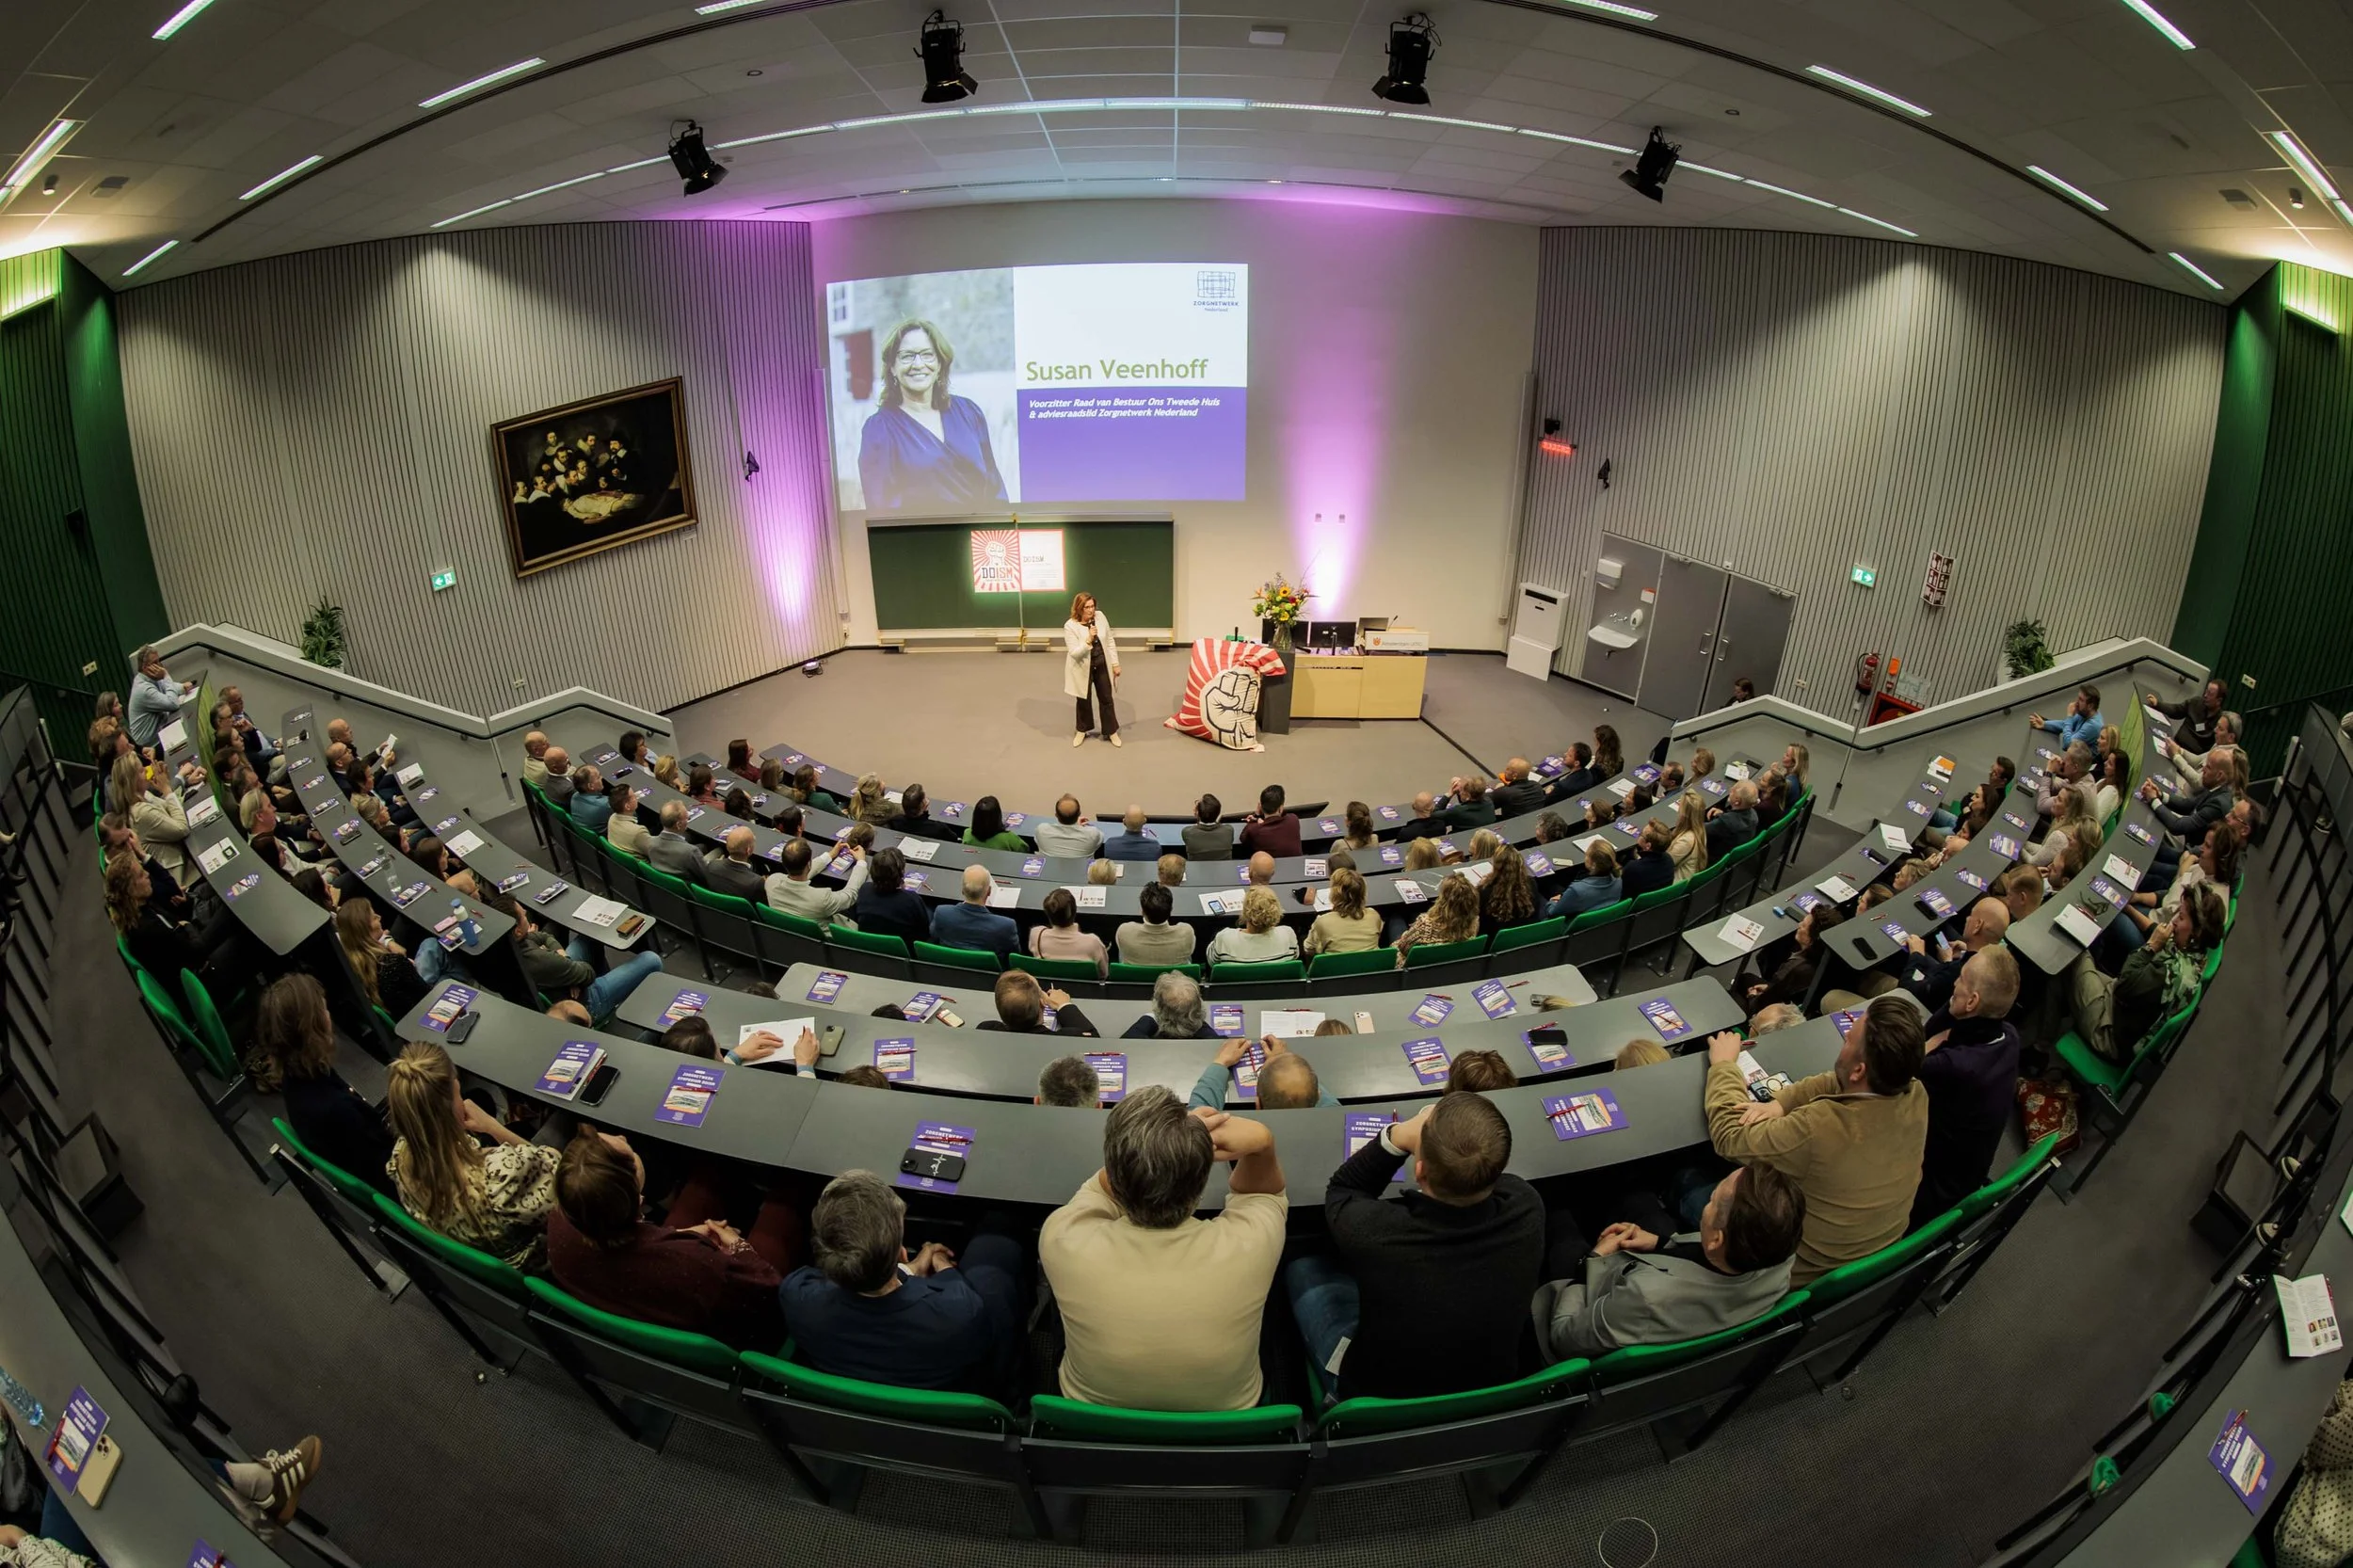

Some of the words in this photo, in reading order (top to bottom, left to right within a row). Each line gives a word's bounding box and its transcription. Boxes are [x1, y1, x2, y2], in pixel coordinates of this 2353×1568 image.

[1026, 361, 1092, 381] Susan
[1099, 359, 1209, 379] Veenhoff
[1029, 399, 1072, 408] Voorzitter
[1073, 398, 1096, 407] Raad
[1112, 397, 1147, 407] Bestuur
[1147, 397, 1165, 406] Ons
[1166, 397, 1200, 406] Tweede
[1201, 397, 1221, 406] Huis
[1029, 410, 1036, 419] &
[1037, 408, 1098, 419] adviesraadslid
[1097, 408, 1153, 419] Zorgnetwerk
[1153, 408, 1199, 417] Nederland
[982, 567, 1013, 579] DOISM
